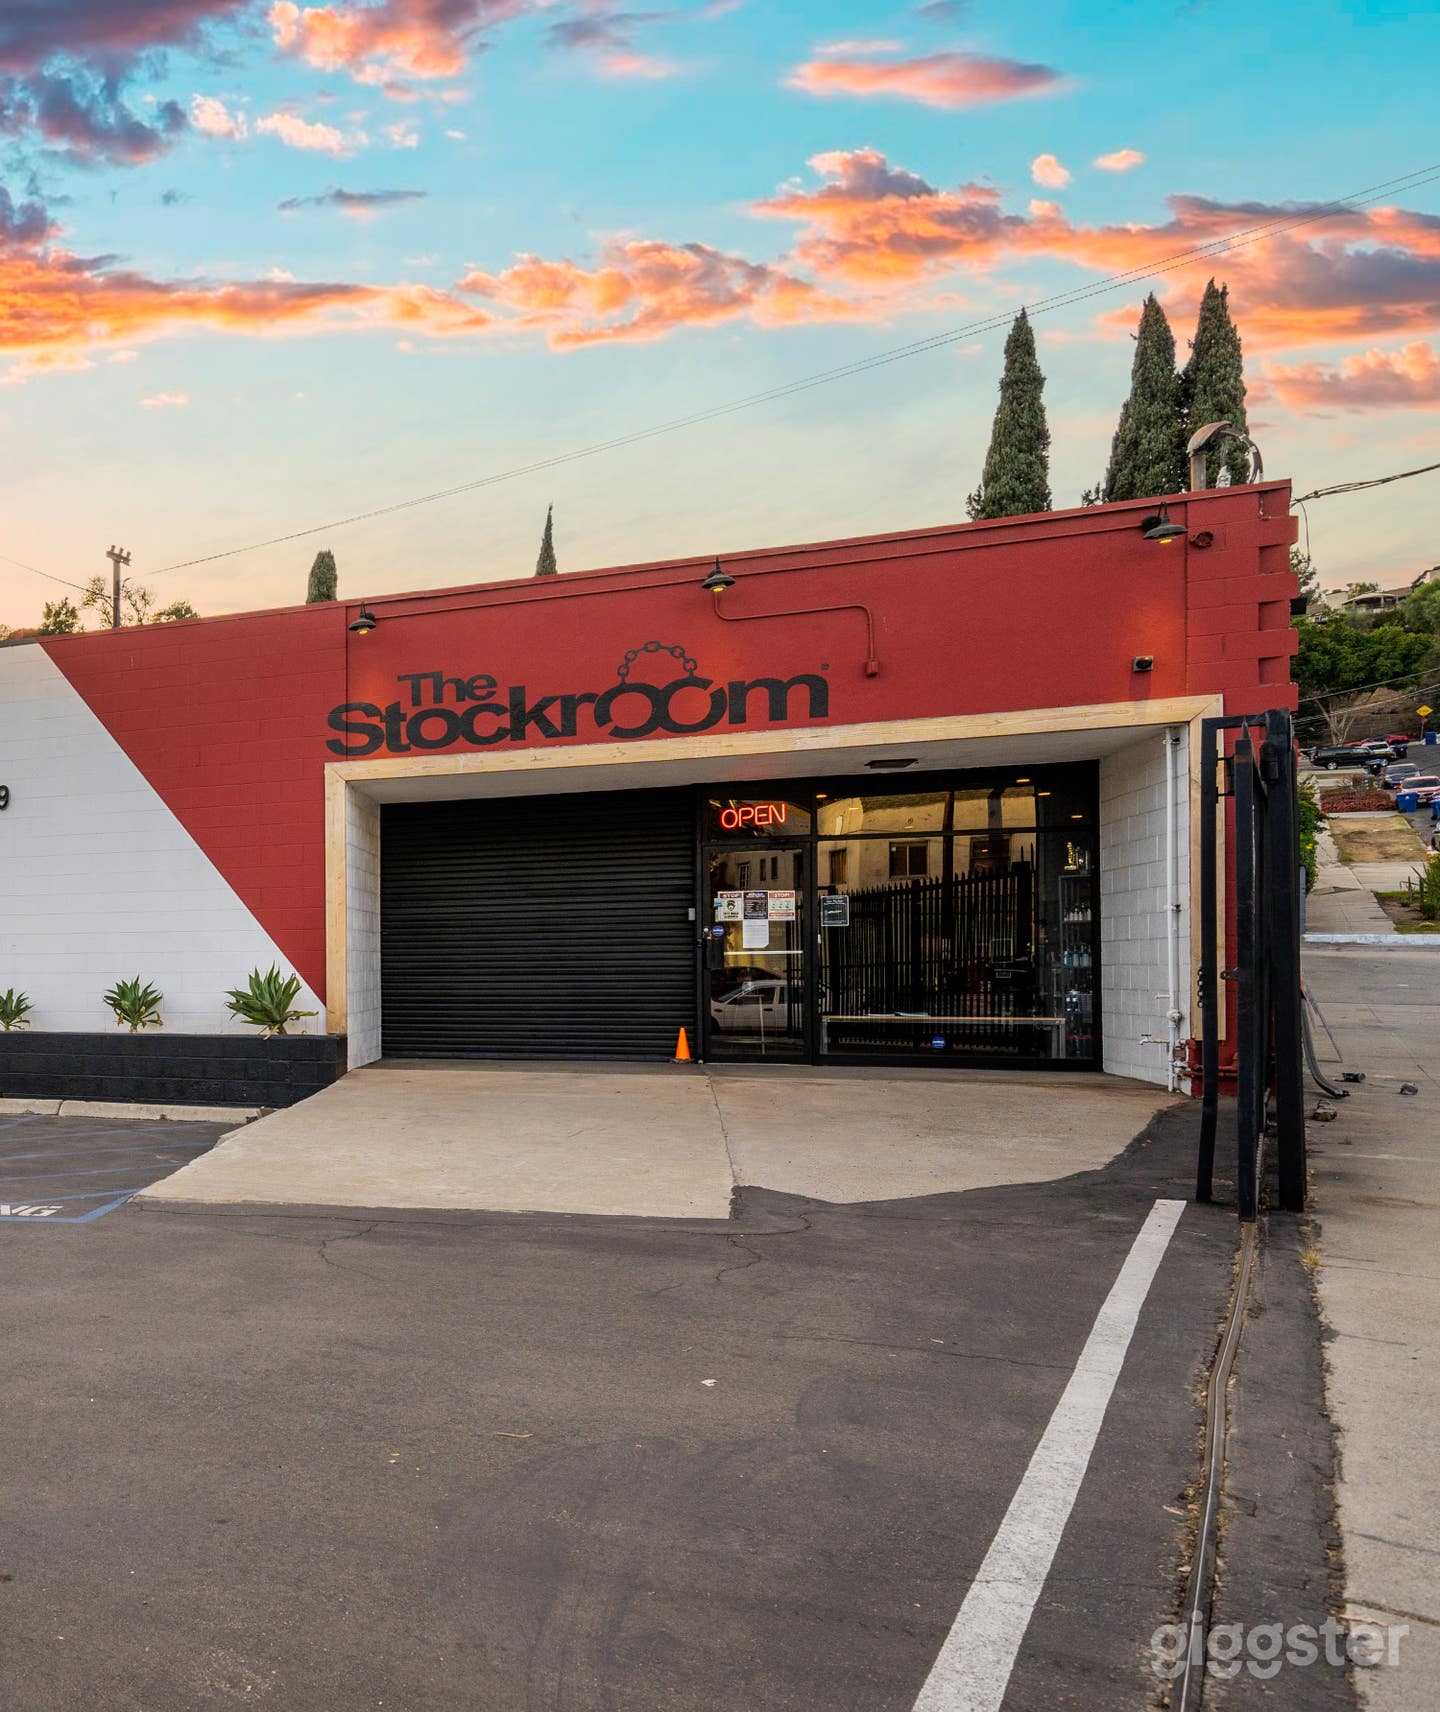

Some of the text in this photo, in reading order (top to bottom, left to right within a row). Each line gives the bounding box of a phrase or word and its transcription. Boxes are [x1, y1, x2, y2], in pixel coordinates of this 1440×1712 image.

[397, 671, 498, 706] The
[325, 673, 829, 756] Stockroom
[721, 803, 786, 829] OPEN
